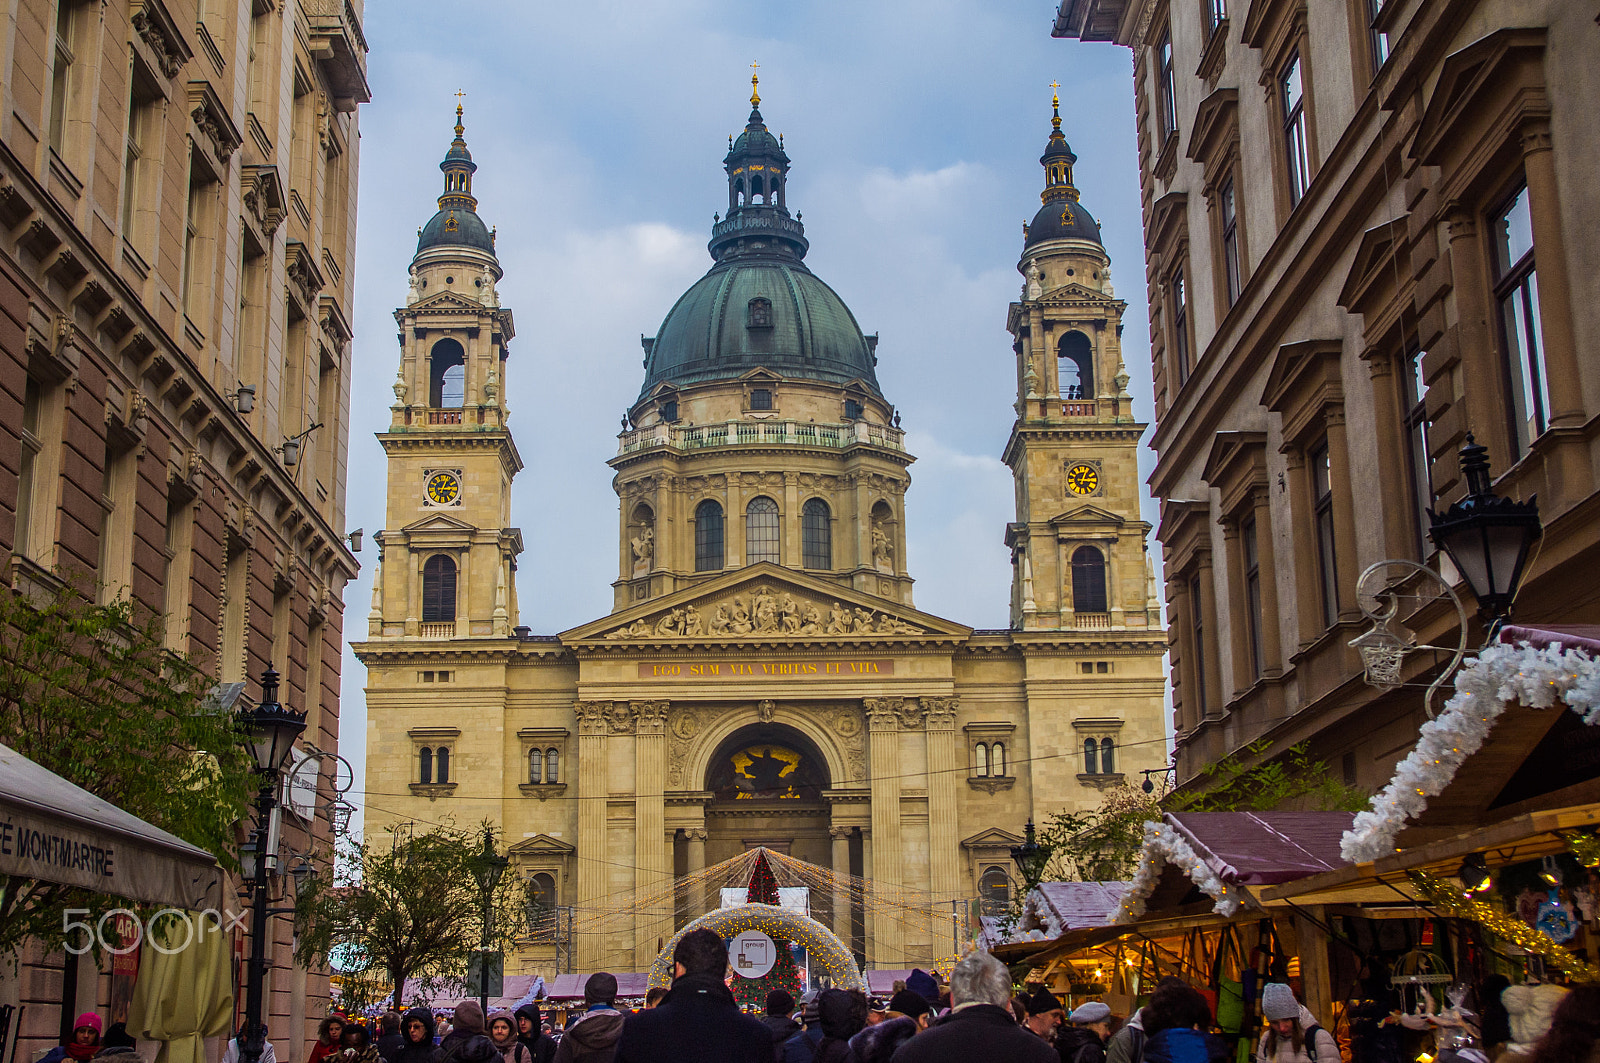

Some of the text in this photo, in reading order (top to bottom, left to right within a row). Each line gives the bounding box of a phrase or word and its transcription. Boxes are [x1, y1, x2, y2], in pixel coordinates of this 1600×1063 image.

[653, 662, 879, 676] EGO SUM VIA VERITAS ET VITA
[16, 827, 114, 877] MONTMARTRE
